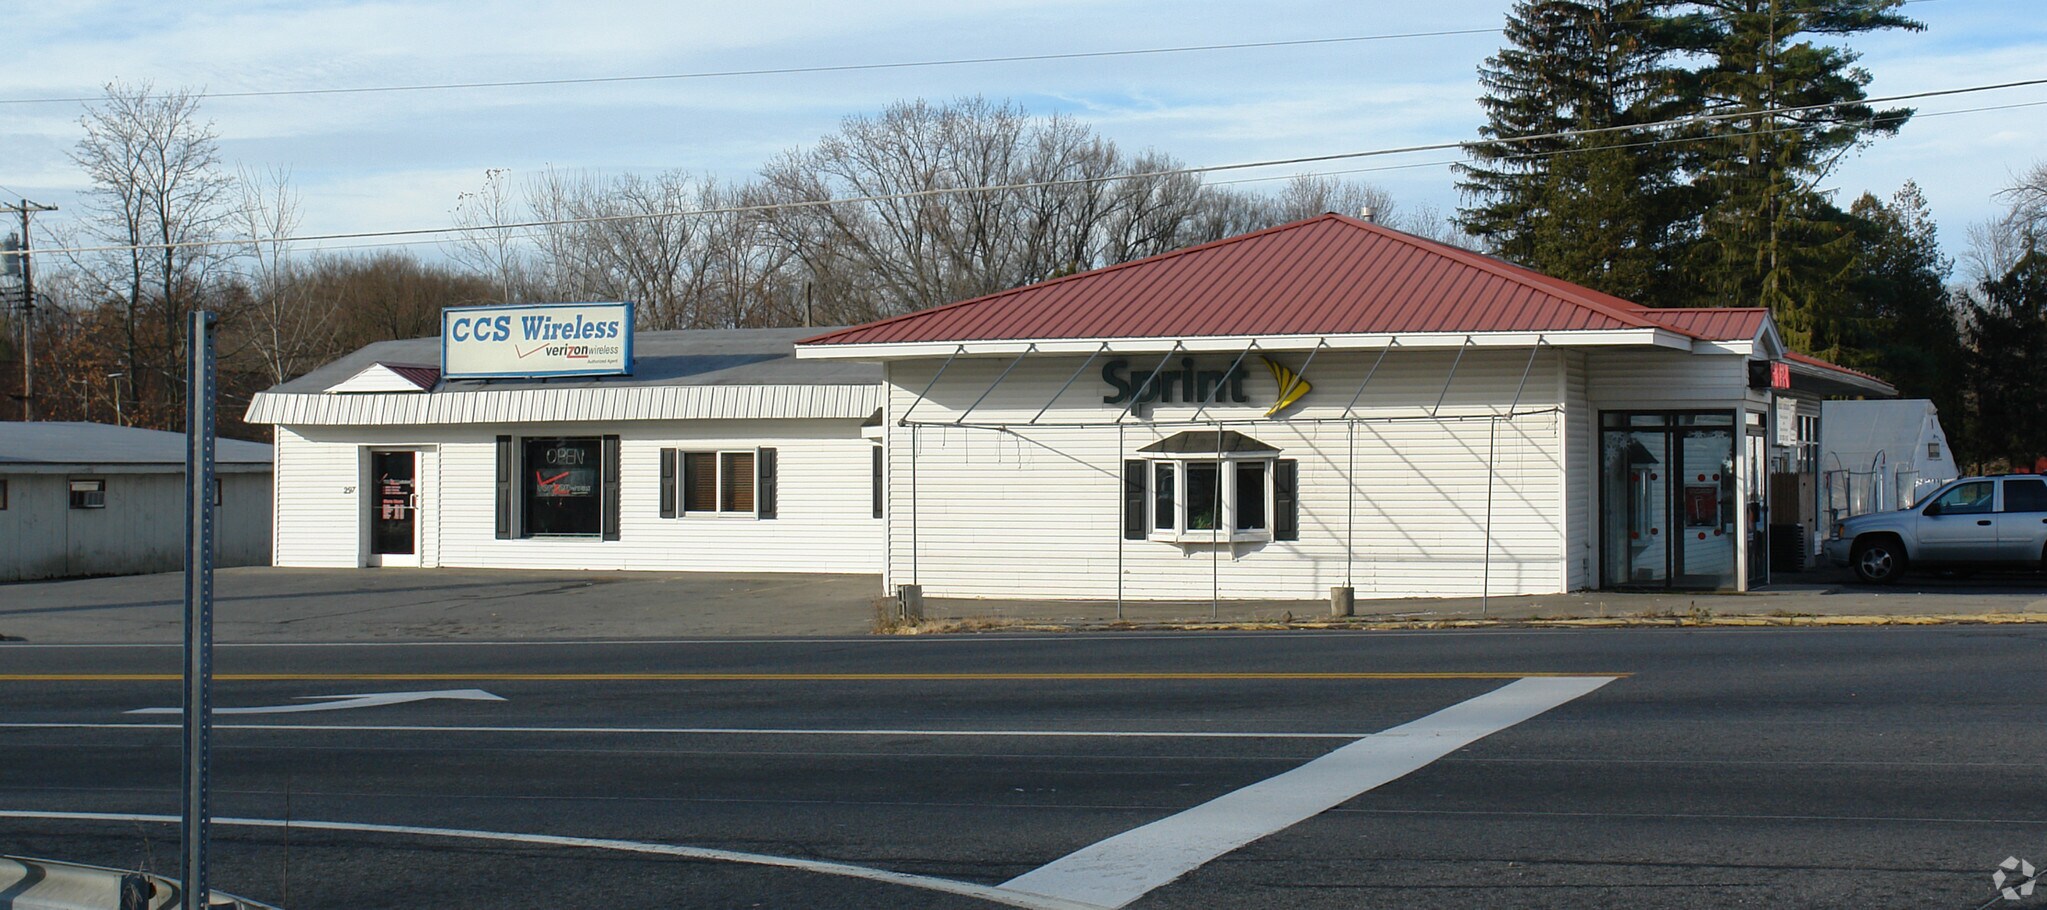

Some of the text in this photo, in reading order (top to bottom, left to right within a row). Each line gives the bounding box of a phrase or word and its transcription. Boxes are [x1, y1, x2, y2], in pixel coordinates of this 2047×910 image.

[452, 314, 619, 342] CCS Wireless
[1102, 357, 1250, 417] Sprint
[546, 448, 585, 465] OPEN
